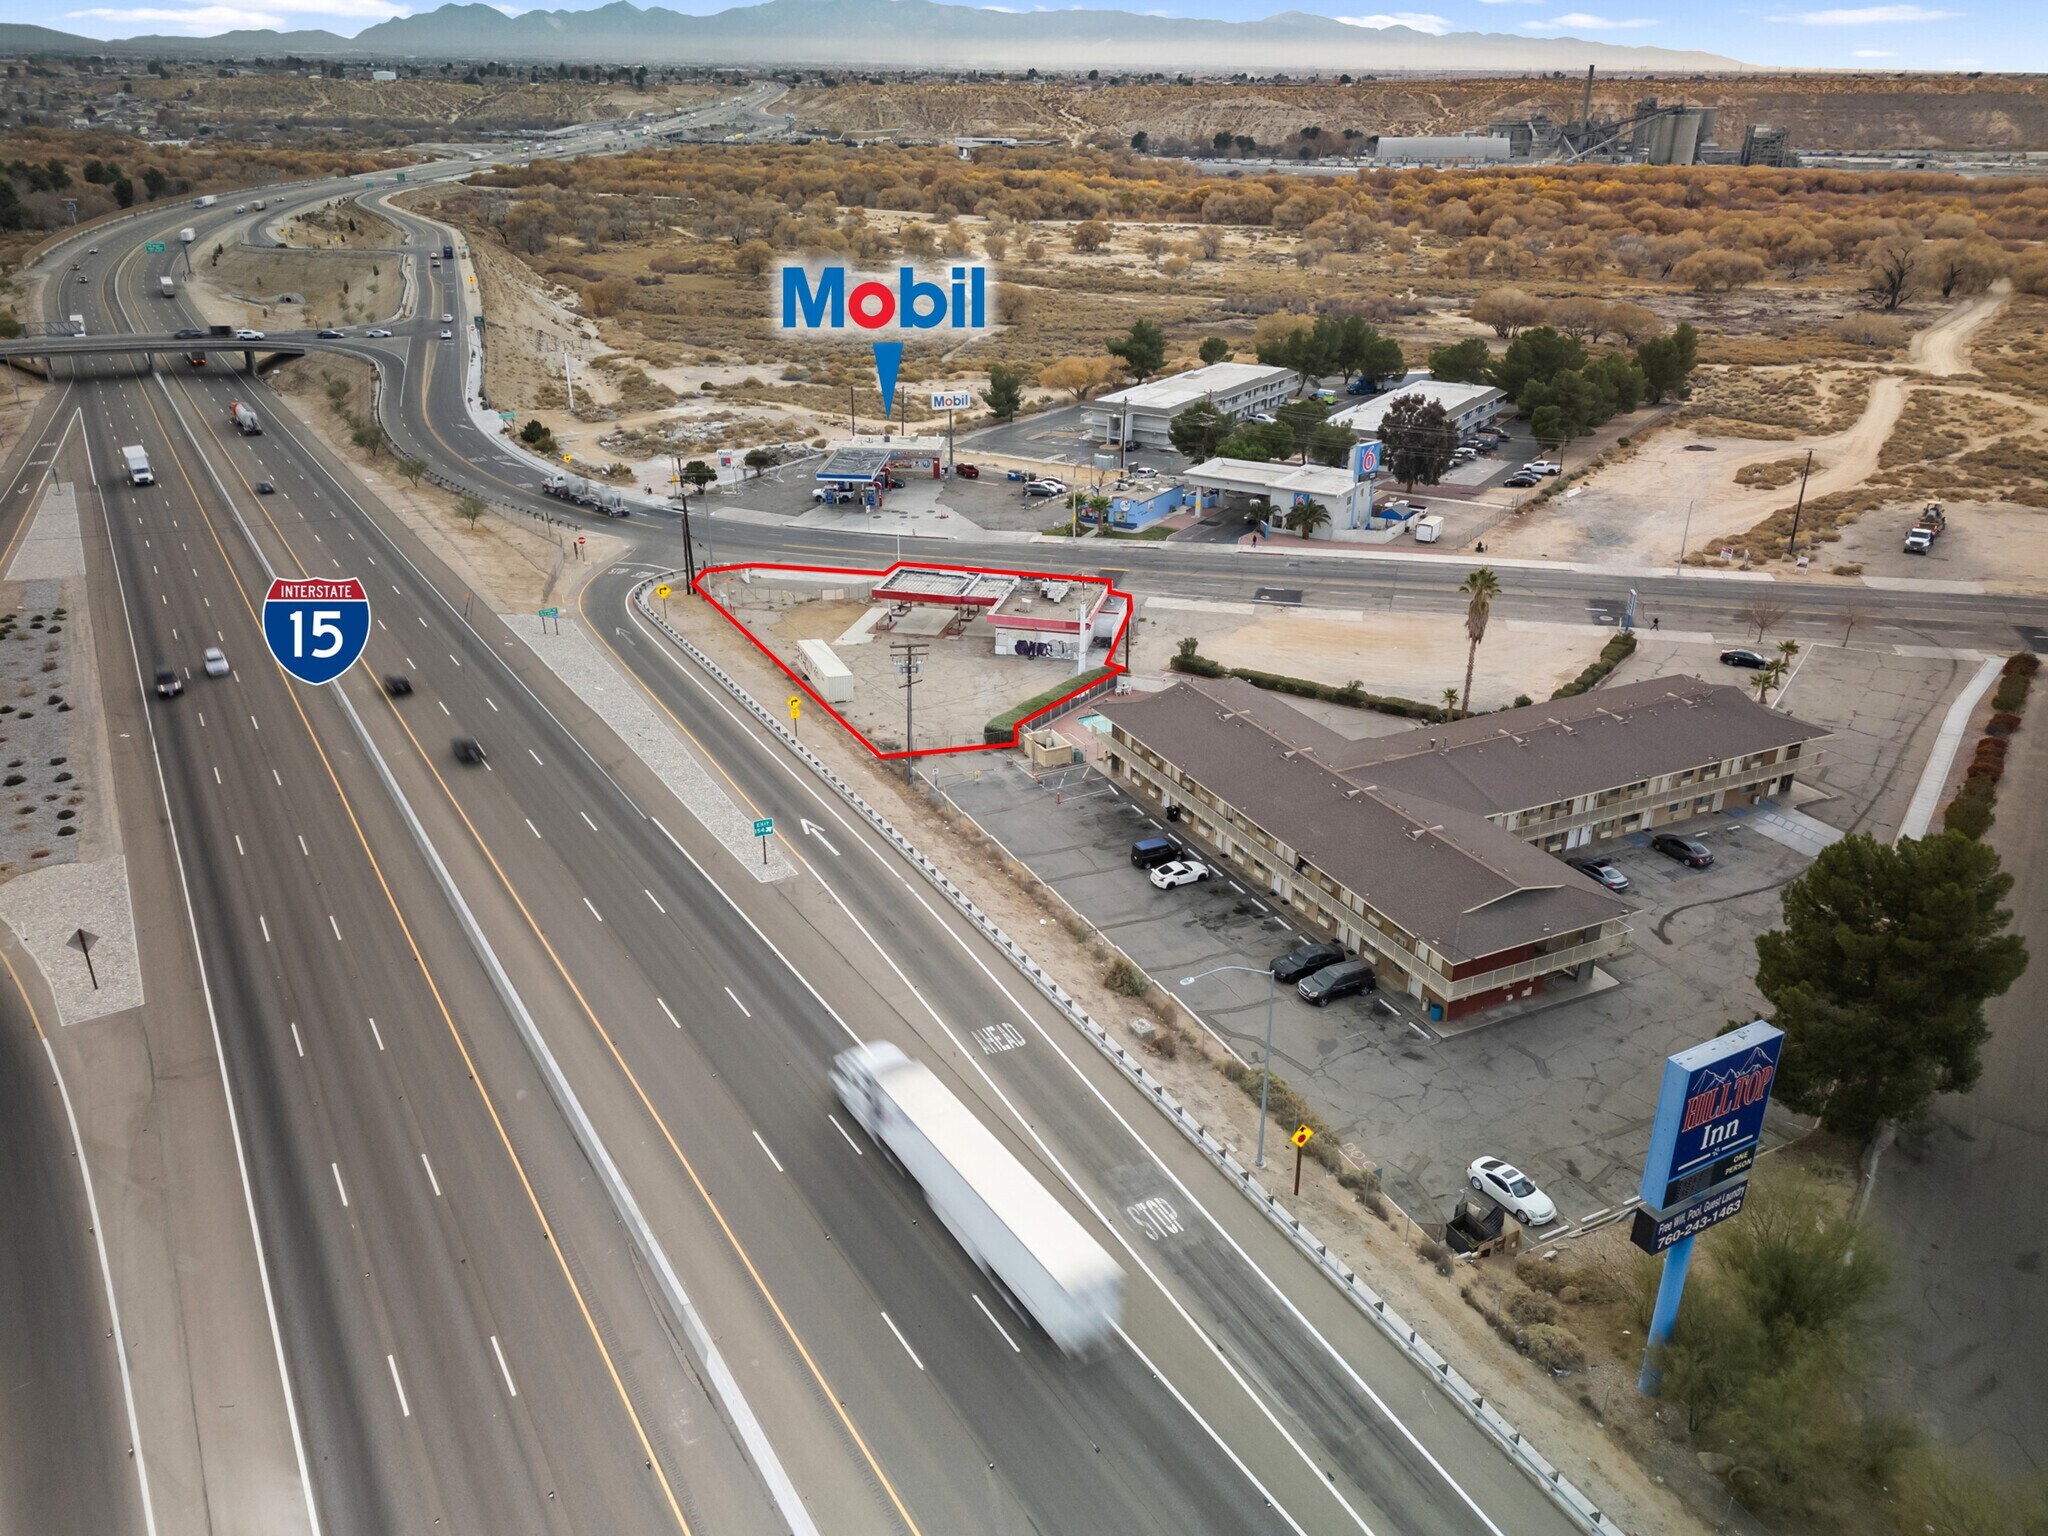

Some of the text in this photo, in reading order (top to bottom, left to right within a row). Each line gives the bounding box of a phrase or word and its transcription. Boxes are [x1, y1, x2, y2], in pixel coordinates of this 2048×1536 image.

[933, 394, 968, 407] Mobil
[1363, 445, 1376, 472] 6
[971, 1022, 1026, 1055] AHEAD
[1700, 1118, 1740, 1150] Inn
[1724, 1159, 1752, 1175] PERSON
[1734, 1151, 1748, 1162] ONE
[1127, 1197, 1184, 1240] STOP
[1657, 1200, 1741, 1249] 760-243-1463
[1658, 1222, 1672, 1235] Free
[1703, 1196, 1721, 1212] Guest
[1721, 1186, 1746, 1204] Laundry
